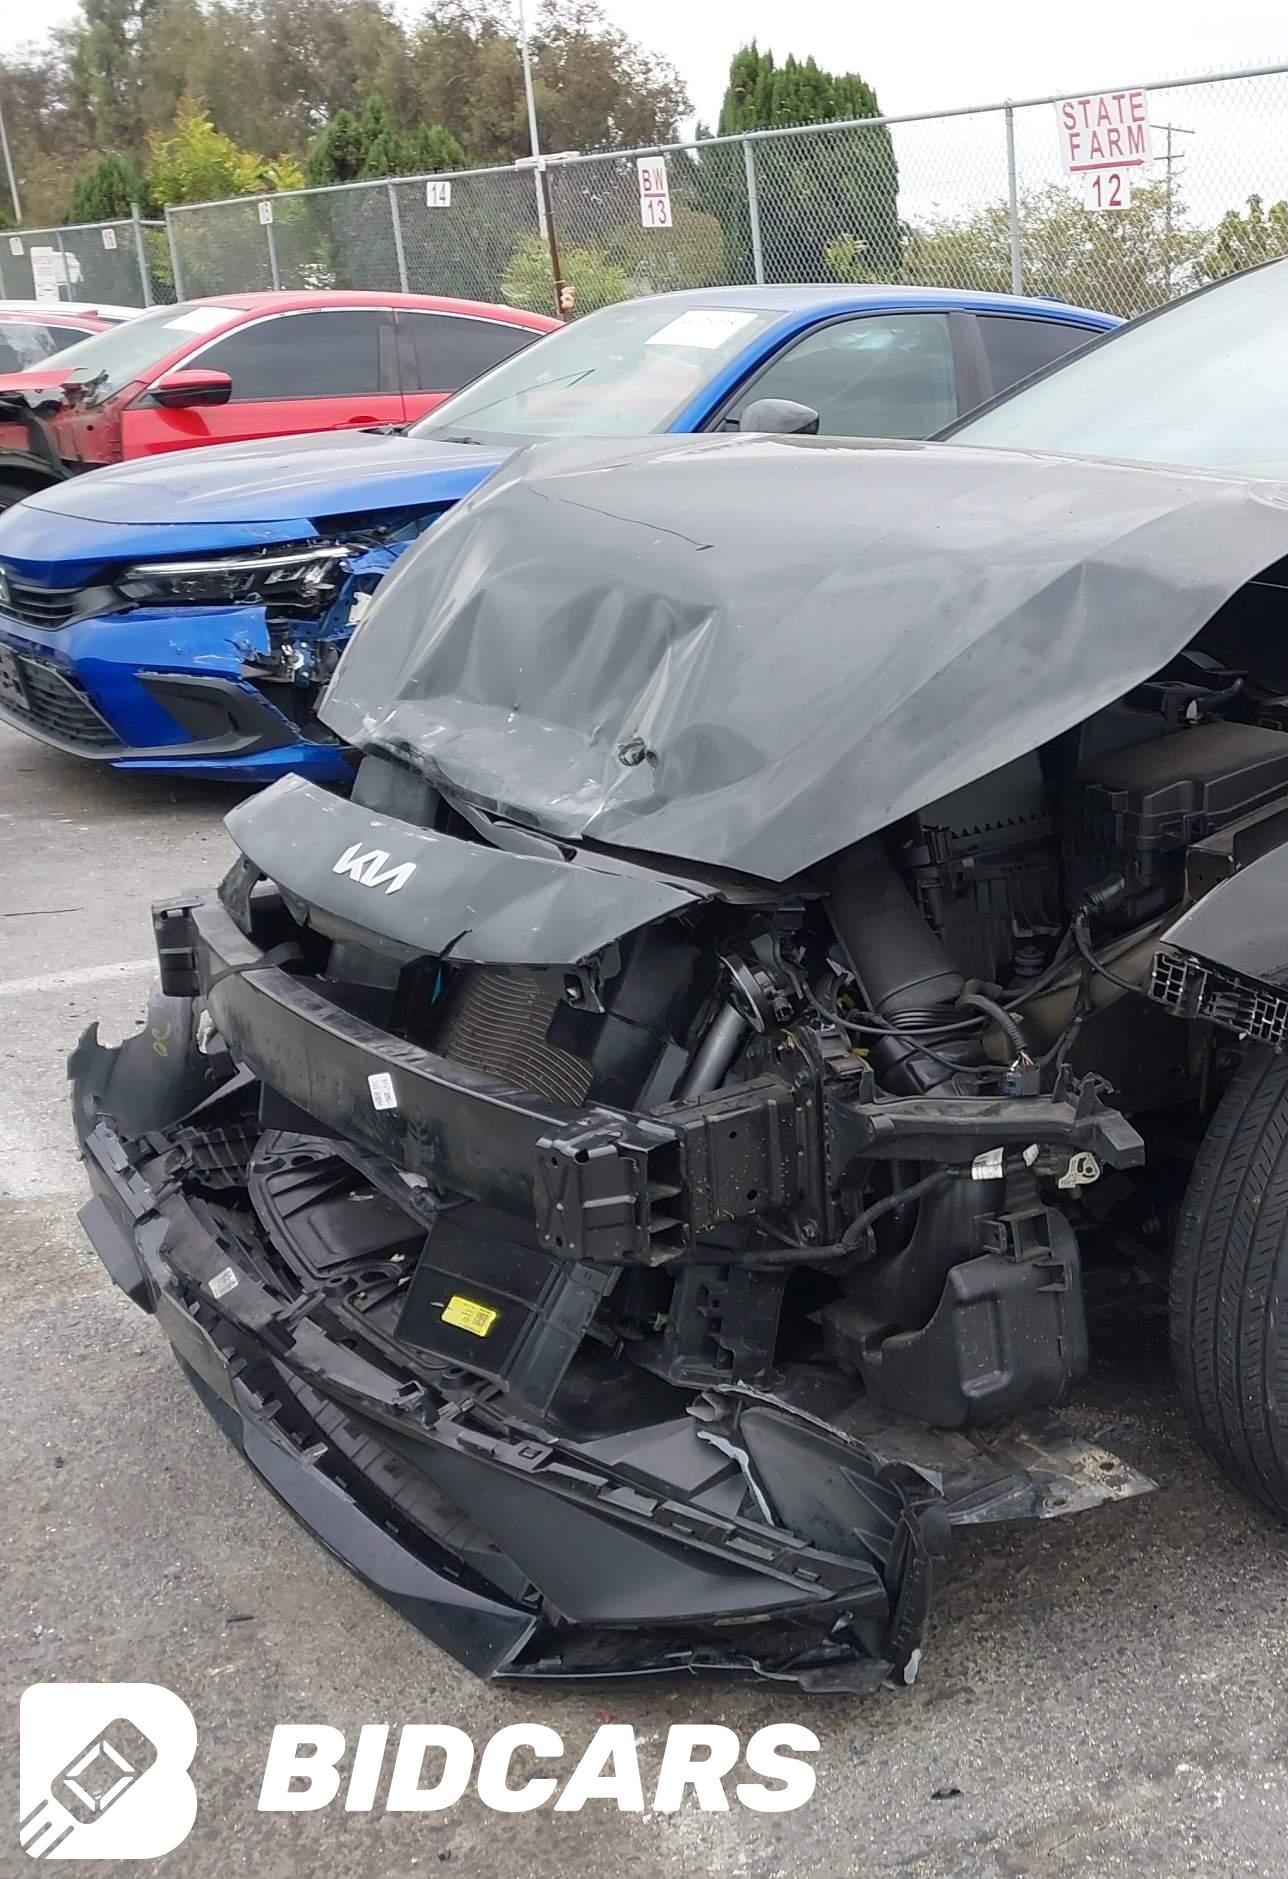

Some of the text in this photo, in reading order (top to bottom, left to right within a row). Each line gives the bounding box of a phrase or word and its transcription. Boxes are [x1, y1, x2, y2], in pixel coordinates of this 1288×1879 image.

[1063, 92, 1145, 130] STATE
[1069, 124, 1145, 161] FARM
[432, 182, 447, 206] 14
[642, 167, 664, 191] BW
[1092, 173, 1122, 207] 12
[648, 199, 667, 224] 13
[332, 842, 417, 895] KIA
